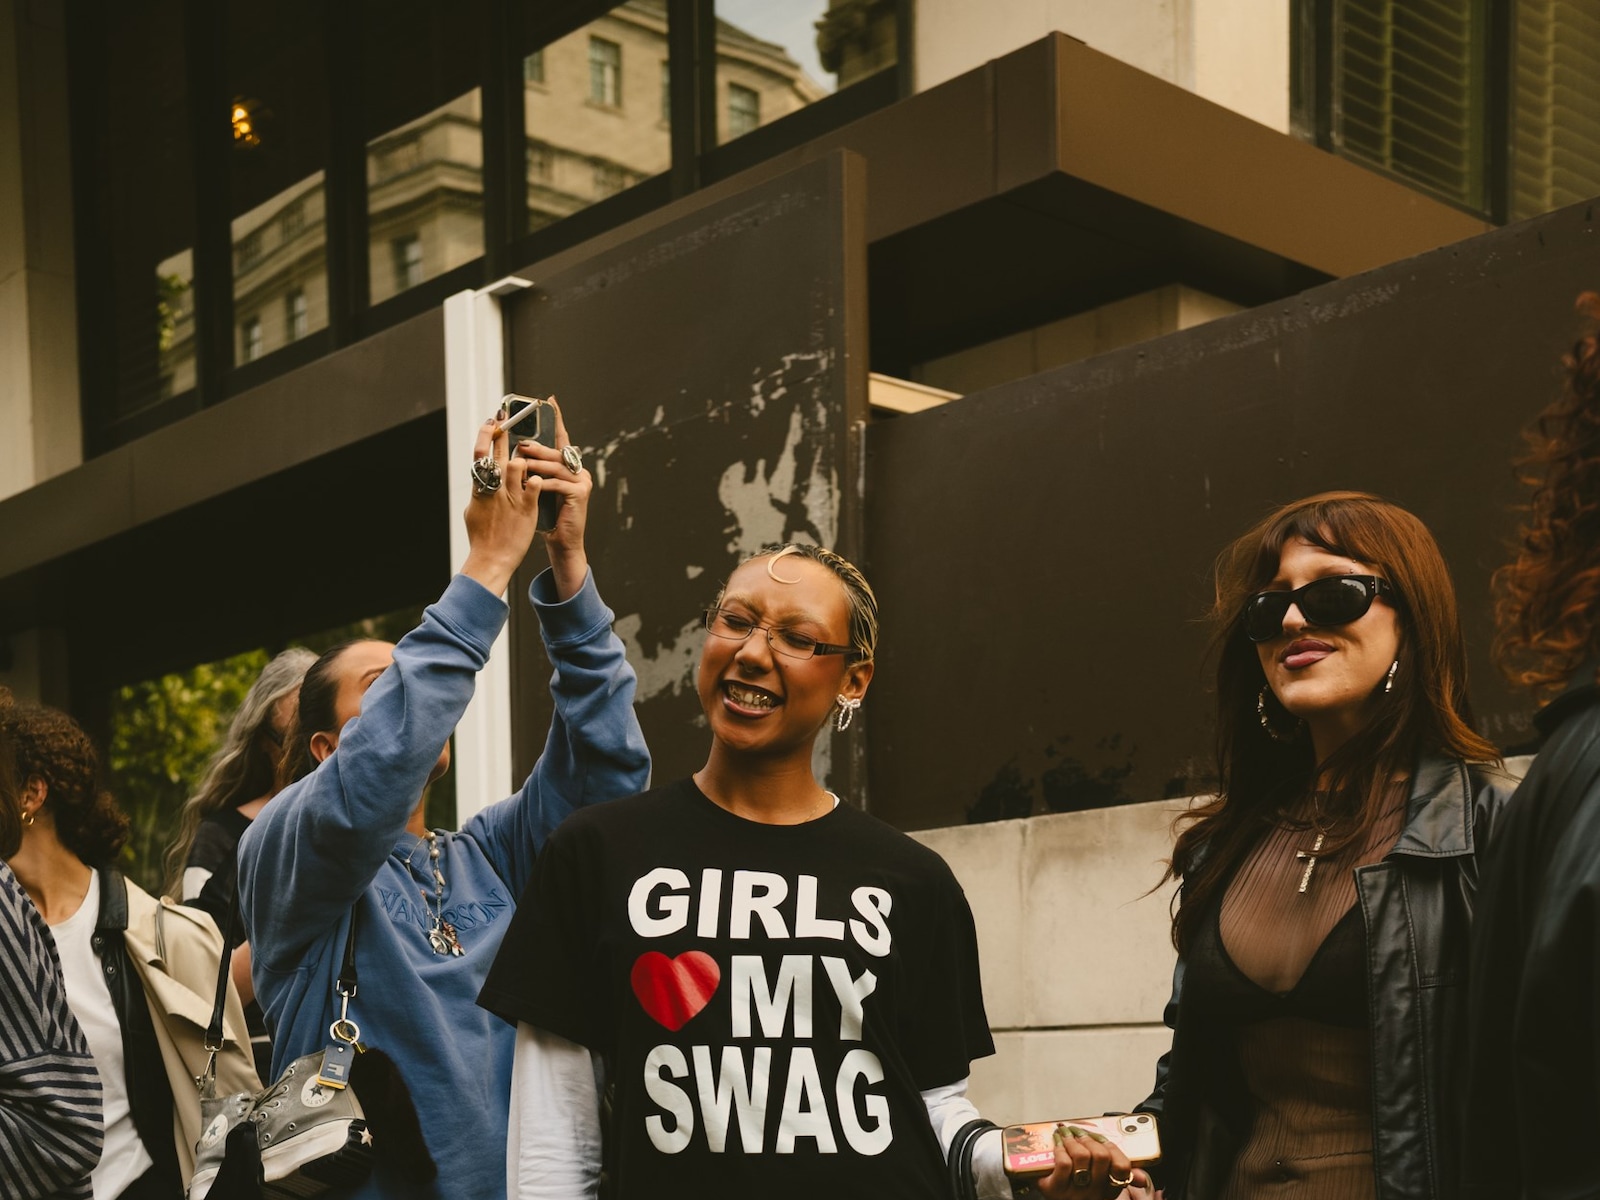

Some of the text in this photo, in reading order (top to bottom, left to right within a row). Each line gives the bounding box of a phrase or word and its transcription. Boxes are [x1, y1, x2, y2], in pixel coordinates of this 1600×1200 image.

[628, 867, 893, 957] GIRLS
[731, 954, 877, 1041] MY
[644, 1044, 893, 1155] SWAG
